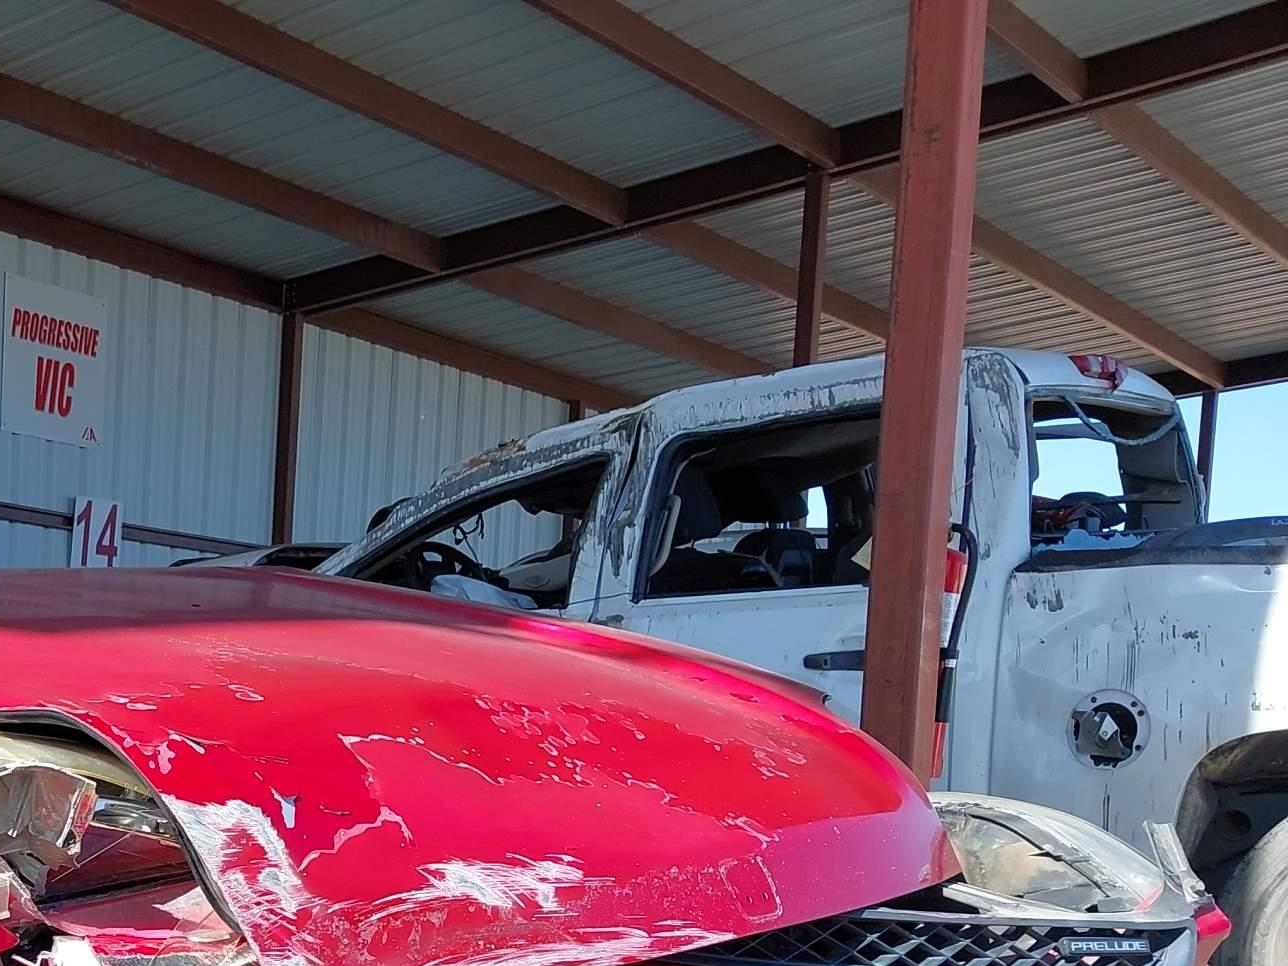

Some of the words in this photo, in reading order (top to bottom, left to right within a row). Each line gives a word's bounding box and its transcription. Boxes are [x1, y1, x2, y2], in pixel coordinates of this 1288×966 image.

[12, 308, 99, 358] PROGRESSIVE
[35, 357, 75, 418] VIC
[77, 500, 118, 567] 14
[1071, 941, 1148, 951] PRELUDE
